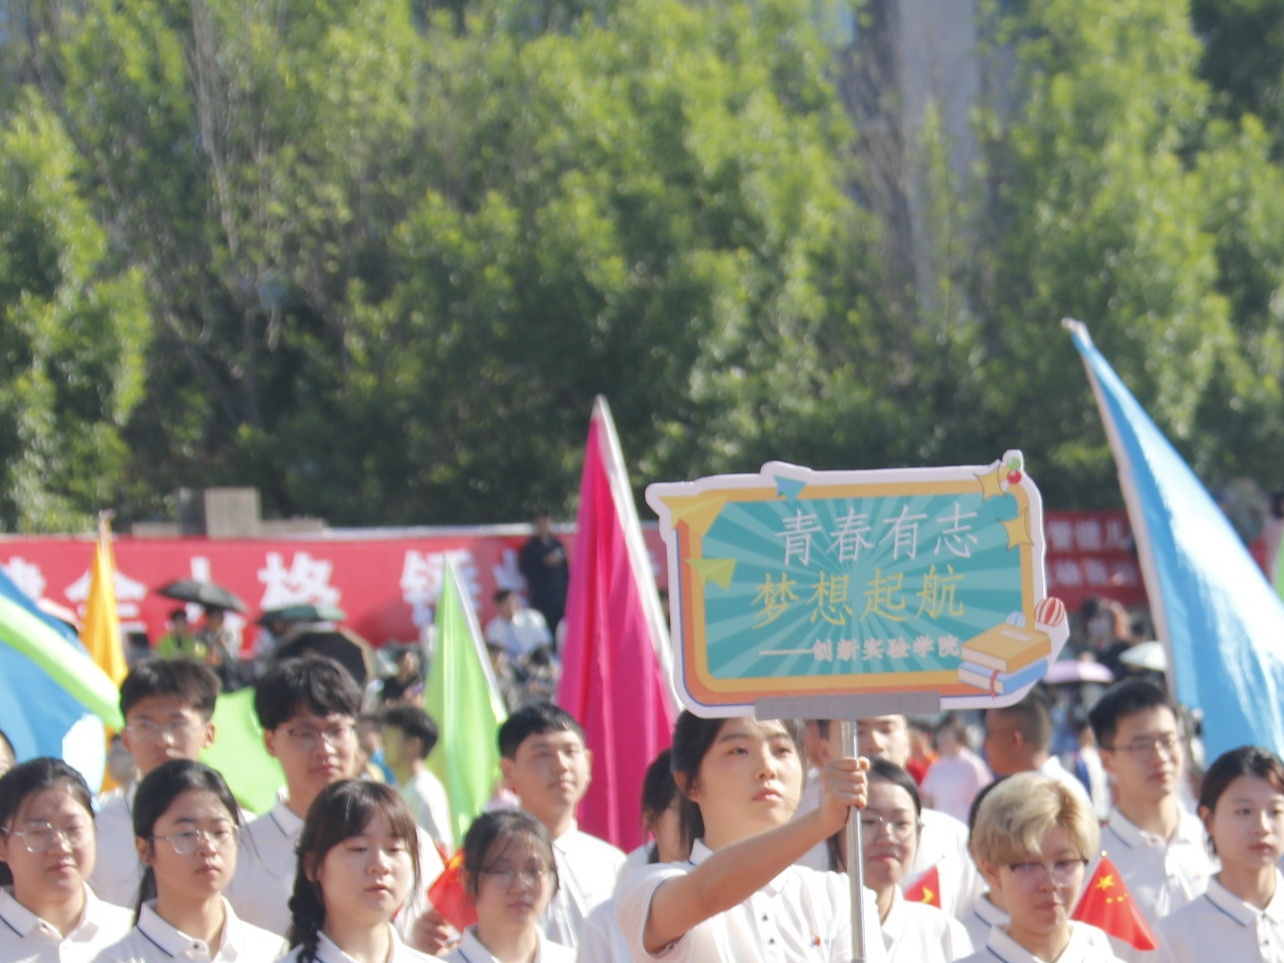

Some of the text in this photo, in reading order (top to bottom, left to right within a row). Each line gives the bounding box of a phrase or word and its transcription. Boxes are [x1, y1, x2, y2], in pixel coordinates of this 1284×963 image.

[774, 502, 979, 566] 青春有志
[750, 564, 966, 630] 梦想起航
